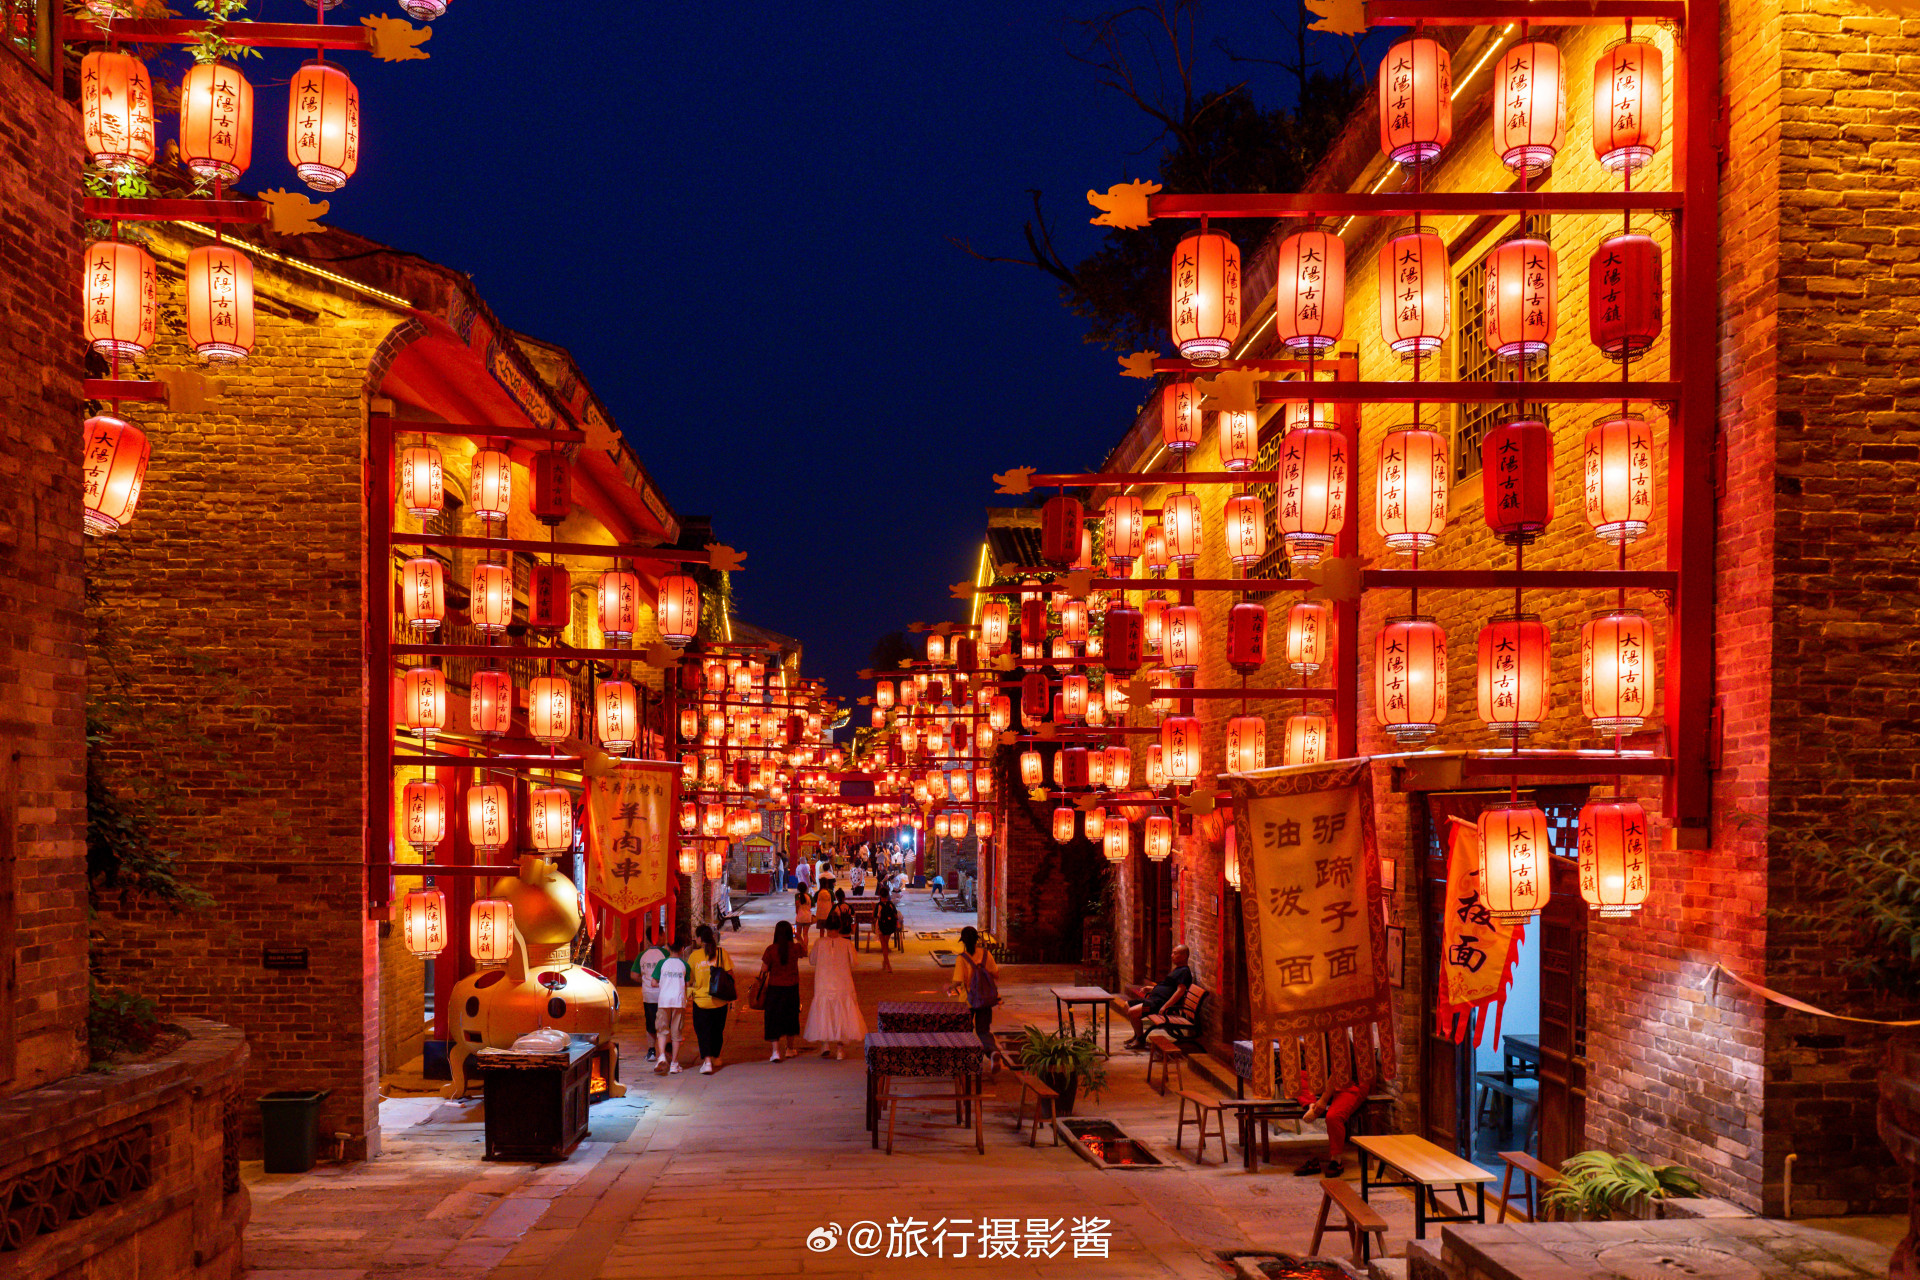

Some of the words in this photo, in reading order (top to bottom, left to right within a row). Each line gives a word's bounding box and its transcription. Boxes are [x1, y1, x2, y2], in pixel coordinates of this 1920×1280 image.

[212, 79, 236, 148] 大陽古鎮
[298, 79, 320, 150] 大陽古鎮
[1391, 57, 1412, 130] 大陽古鎮
[1507, 57, 1529, 130] 大陽古鎮
[1613, 58, 1637, 130] 大陽古鎮
[91, 256, 112, 327] 大陽古鎮
[141, 267, 155, 336] 大陽古鎮
[211, 260, 234, 329] 大陽古鎮
[1176, 253, 1195, 326] 大陽古鎮
[1225, 254, 1238, 328] 大陽古鎮
[1298, 248, 1323, 321] 大陽古鎮
[1399, 249, 1419, 322] 大陽古鎮
[1486, 265, 1498, 336] 大陽古鎮
[1525, 255, 1546, 327] 大陽古鎮
[1601, 251, 1622, 324] 大陽古鎮
[1177, 391, 1190, 433] 大陽古鎮
[431, 459, 442, 502] 大陽古鎮
[1282, 446, 1301, 519] 大陽古鎮
[1329, 447, 1346, 522] 大陽古鎮
[1384, 447, 1402, 520] 大陽古鎮
[1433, 448, 1446, 521] 大陽古鎮
[1499, 438, 1520, 510] 大陽古鎮
[1586, 442, 1600, 512] 大陽古鎮
[1631, 435, 1651, 507] 大陽古鎮
[1166, 506, 1177, 547] 大陽古鎮
[1242, 505, 1255, 547] 大陽古鎮
[418, 568, 432, 610] 大陽古鎮
[475, 573, 485, 615] 大陽古鎮
[621, 582, 632, 623] 大陽古鎮
[684, 586, 694, 628] 大陽古鎮
[1251, 613, 1262, 654] 大陽古鎮
[1303, 613, 1316, 654] 大陽古鎮
[1620, 632, 1642, 704] 大陽古鎮
[421, 677, 433, 719] 大陽古鎮
[1385, 638, 1406, 710] 大陽古鎮
[1435, 638, 1446, 711] 大陽古鎮
[1494, 637, 1516, 709] 大陽古鎮
[552, 689, 564, 730] 大陽古鎮
[607, 691, 621, 732] 大陽古鎮
[1172, 727, 1184, 768] 大陽古鎮
[1229, 728, 1239, 769] 大陽古鎮
[411, 793, 423, 835] 大陽古鎮
[483, 795, 497, 837] 大陽古鎮
[534, 799, 546, 841] 大陽古鎮
[611, 802, 647, 885] 羊肉串
[1511, 827, 1535, 897] 大陽古鎮
[1580, 823, 1596, 892] 大陽古鎮
[1626, 821, 1645, 892] 大陽古鎮
[426, 902, 440, 943] 大陽古鎮
[1264, 817, 1314, 987] 油泼面
[1312, 812, 1359, 980] 驴蹄子面
[1448, 870, 1496, 973] 板面
[479, 911, 492, 953] 大陽古鎮
